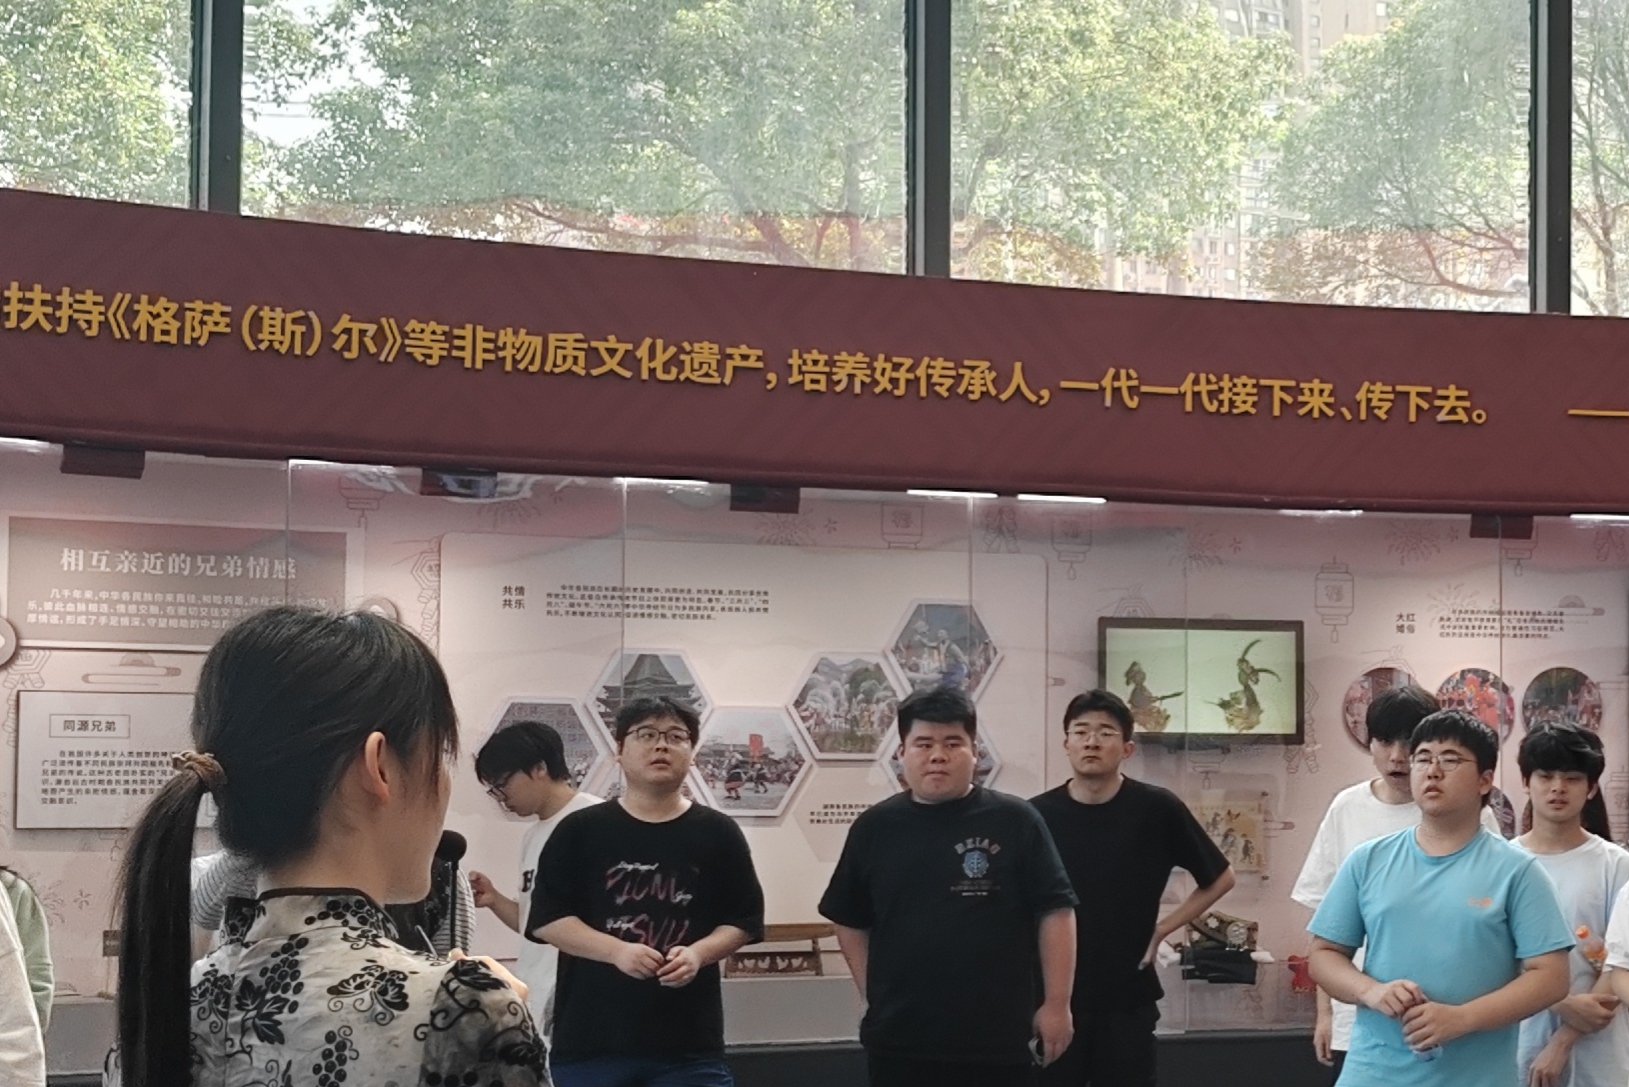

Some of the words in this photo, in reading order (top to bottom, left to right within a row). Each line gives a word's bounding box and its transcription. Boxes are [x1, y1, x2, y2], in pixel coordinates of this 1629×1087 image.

[59, 546, 297, 581] 相互亲近的兄弟情感
[62, 719, 117, 734] 同源兄弟
